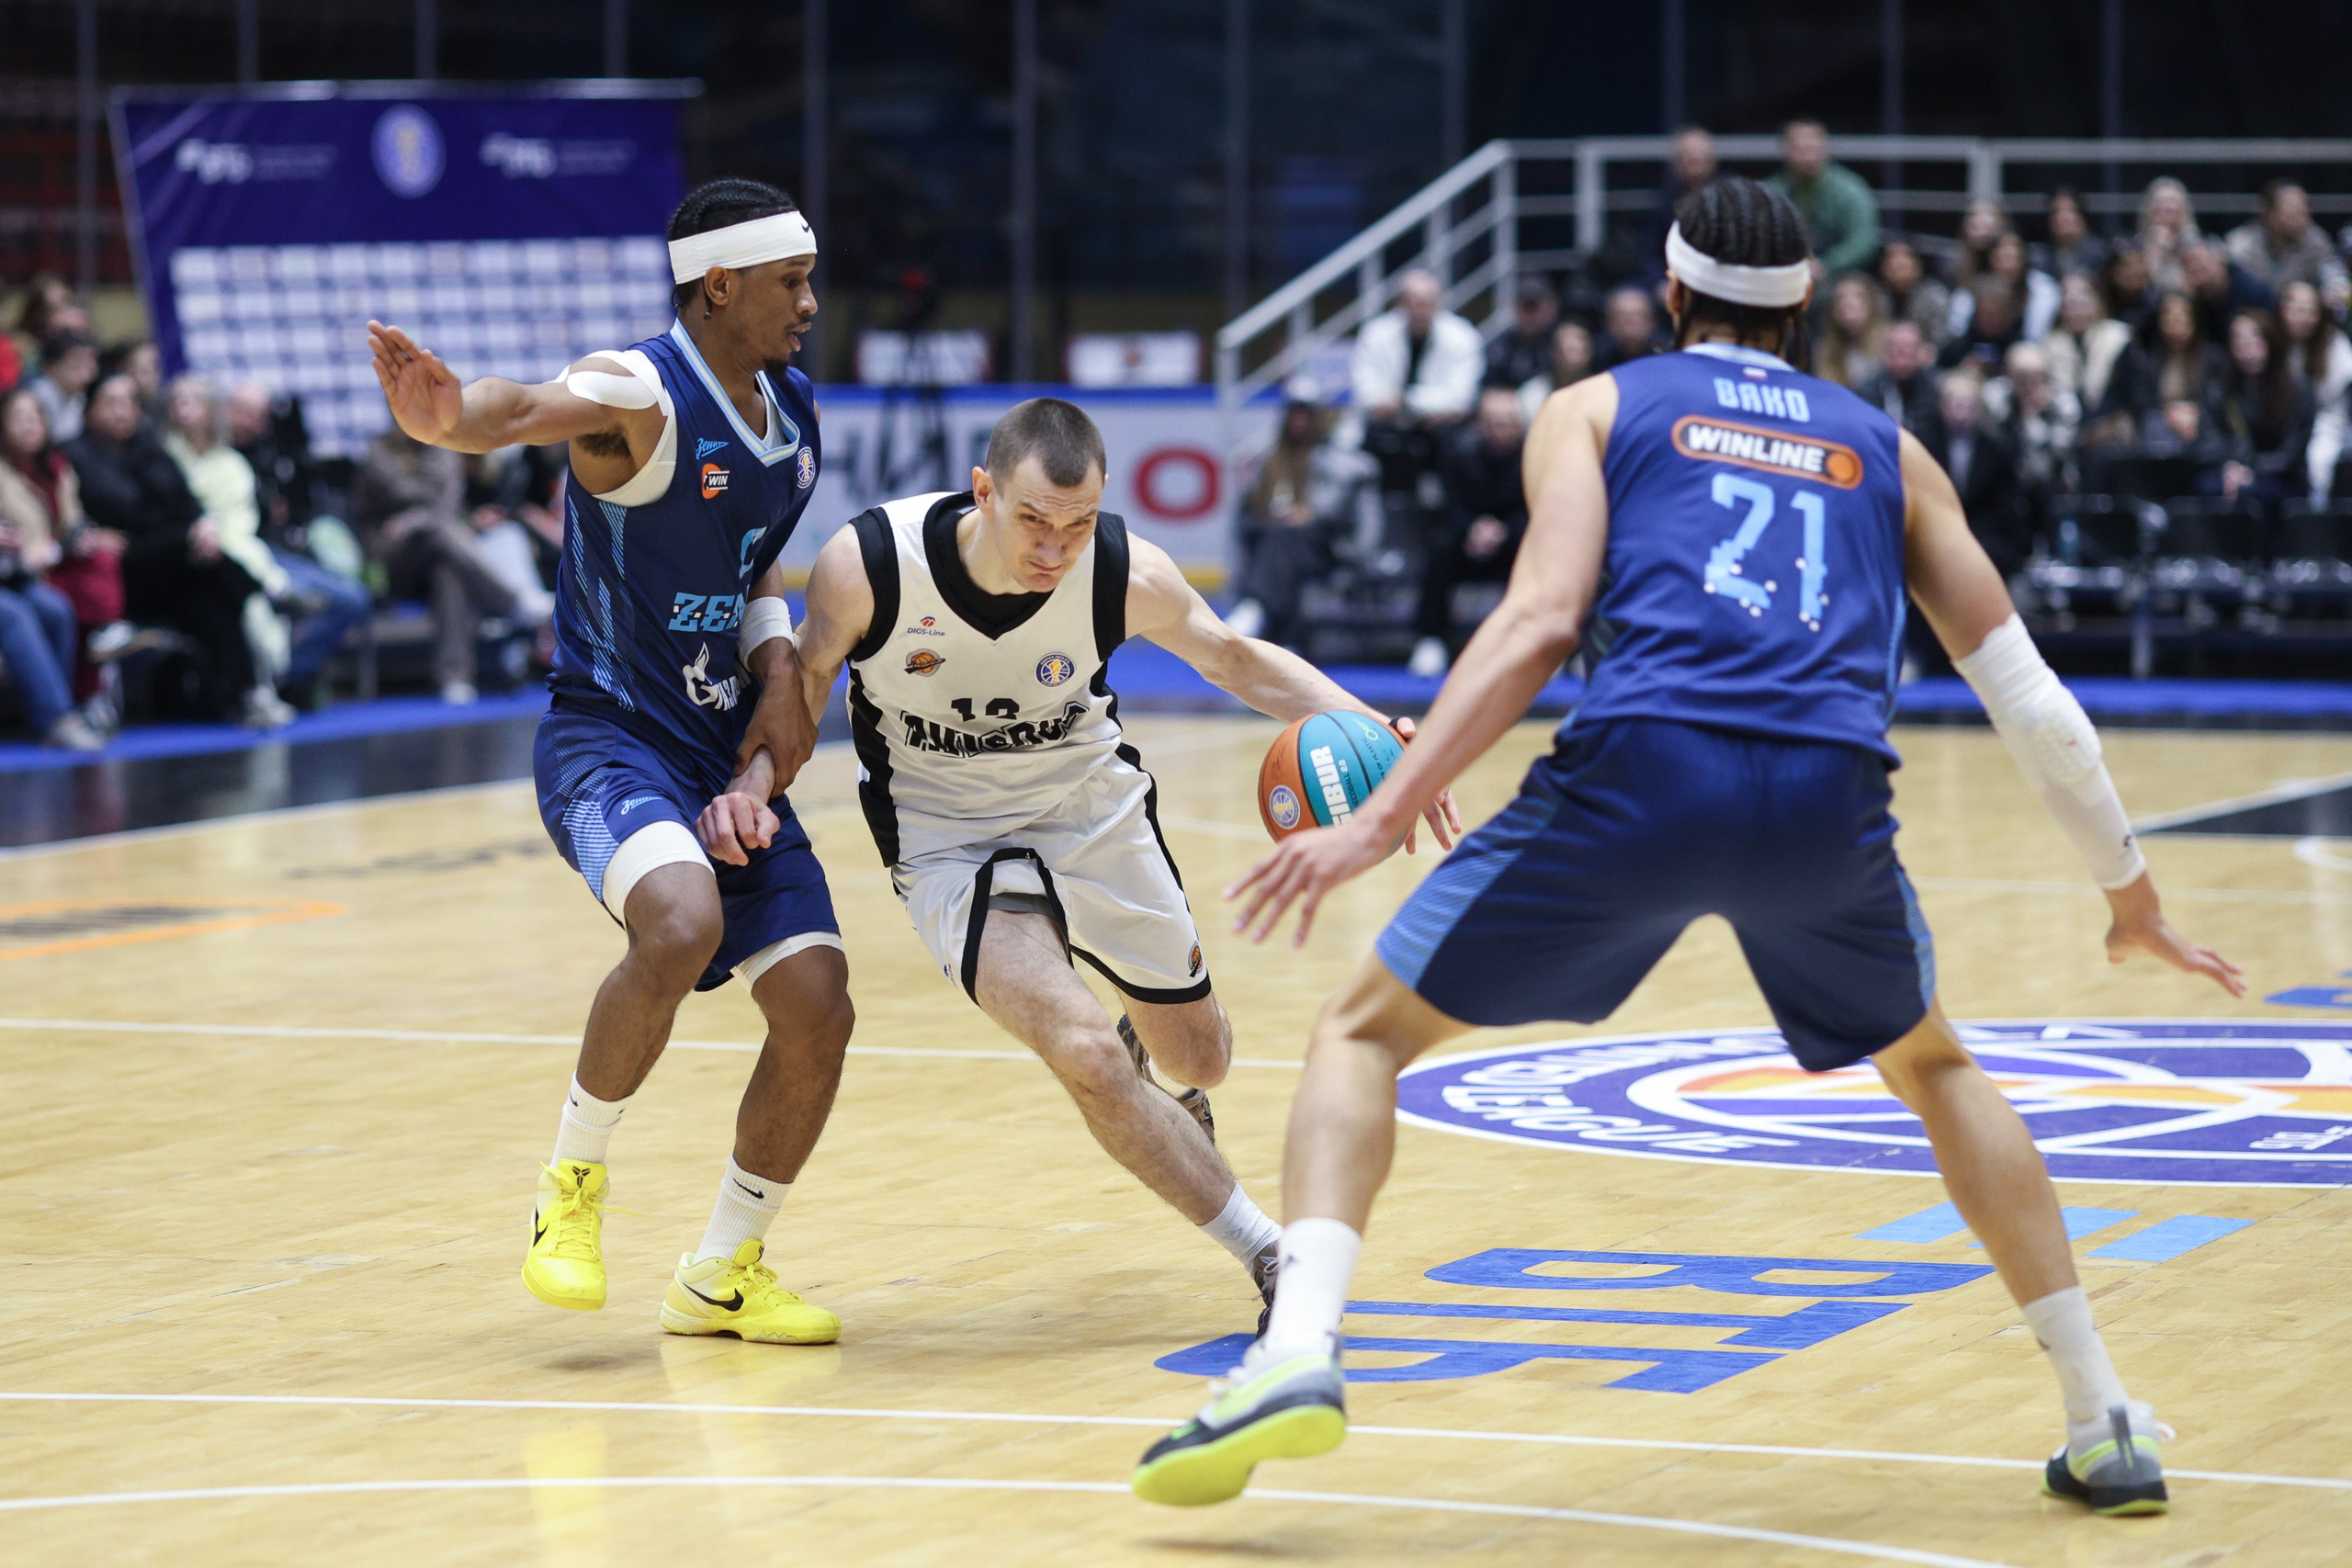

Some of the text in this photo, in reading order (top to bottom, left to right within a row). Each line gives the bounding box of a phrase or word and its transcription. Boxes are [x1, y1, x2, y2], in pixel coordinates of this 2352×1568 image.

[1713, 377, 1810, 423] BAKO
[1688, 423, 1826, 473] WINLINE
[708, 474, 729, 486] WIN
[1705, 472, 1828, 625] 21
[907, 627, 945, 637] DIGS-Line
[1442, 1085, 1799, 1153] LEAGUE
